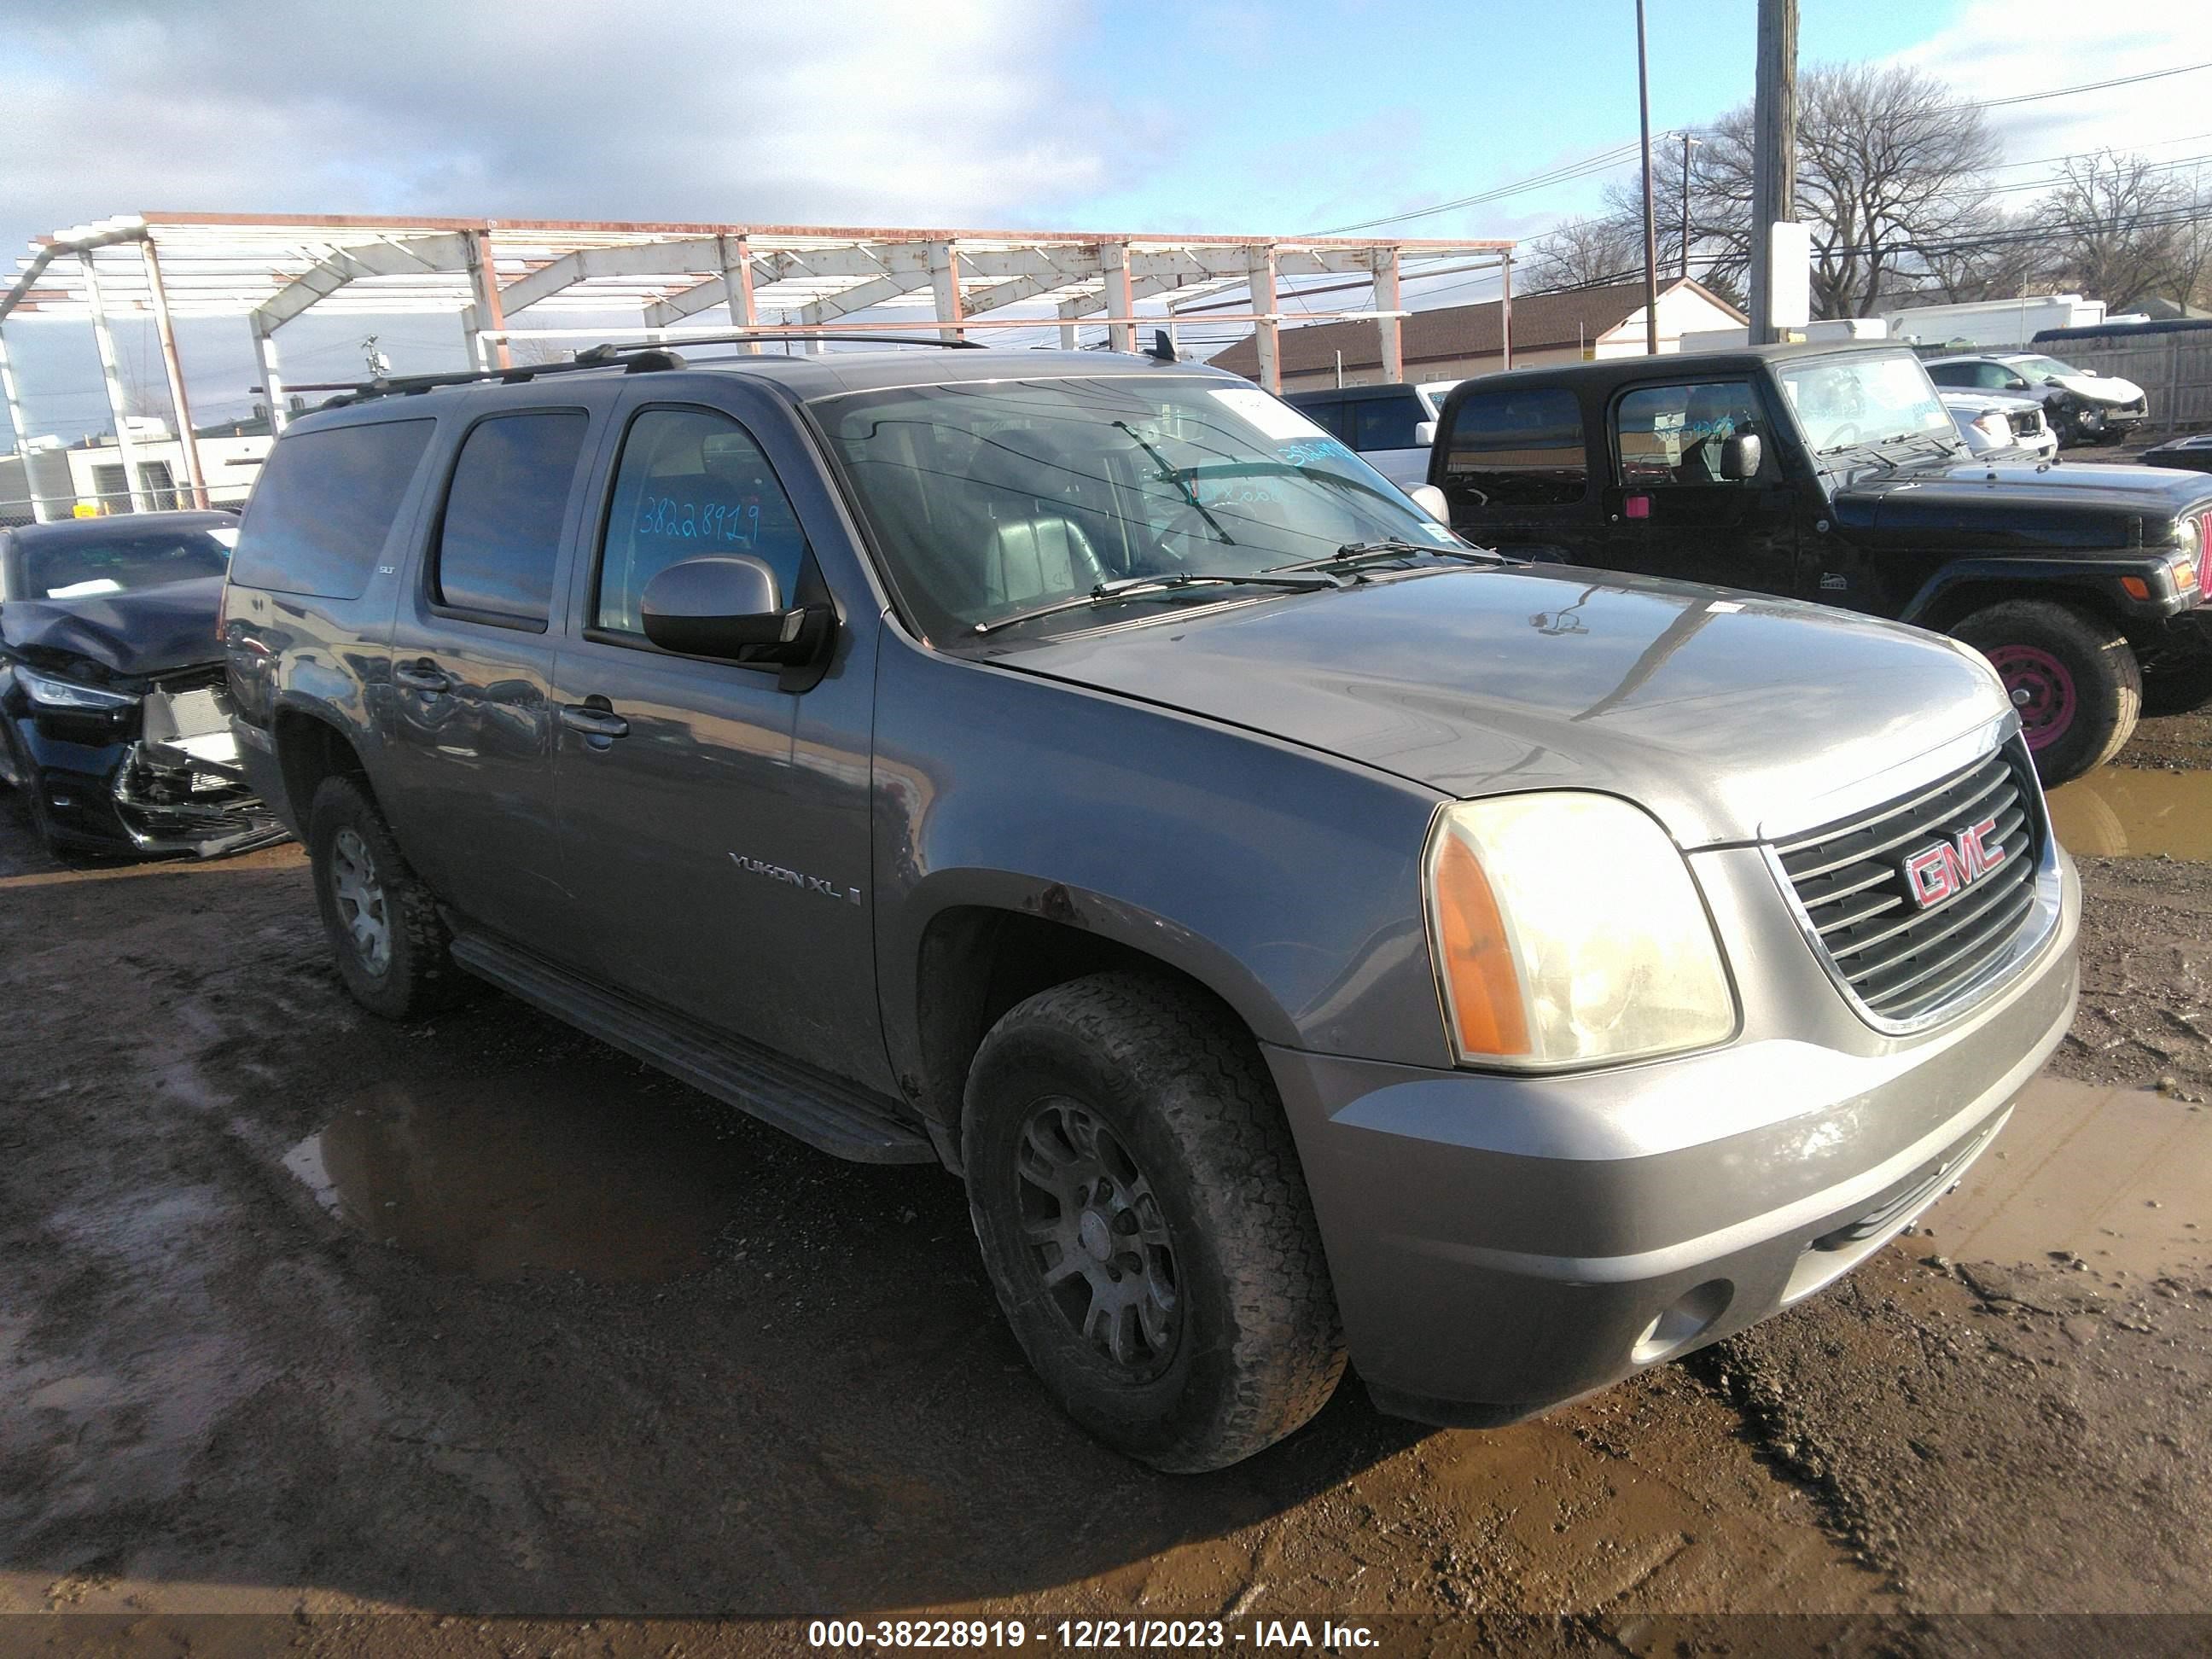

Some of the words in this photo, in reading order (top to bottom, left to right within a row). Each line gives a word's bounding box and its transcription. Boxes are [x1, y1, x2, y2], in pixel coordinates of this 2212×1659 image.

[640, 497, 759, 541] 38228919
[378, 565, 396, 574] SLT
[728, 852, 805, 888] YUKON
[808, 876, 842, 898] XL
[1903, 816, 2006, 910] GMC
